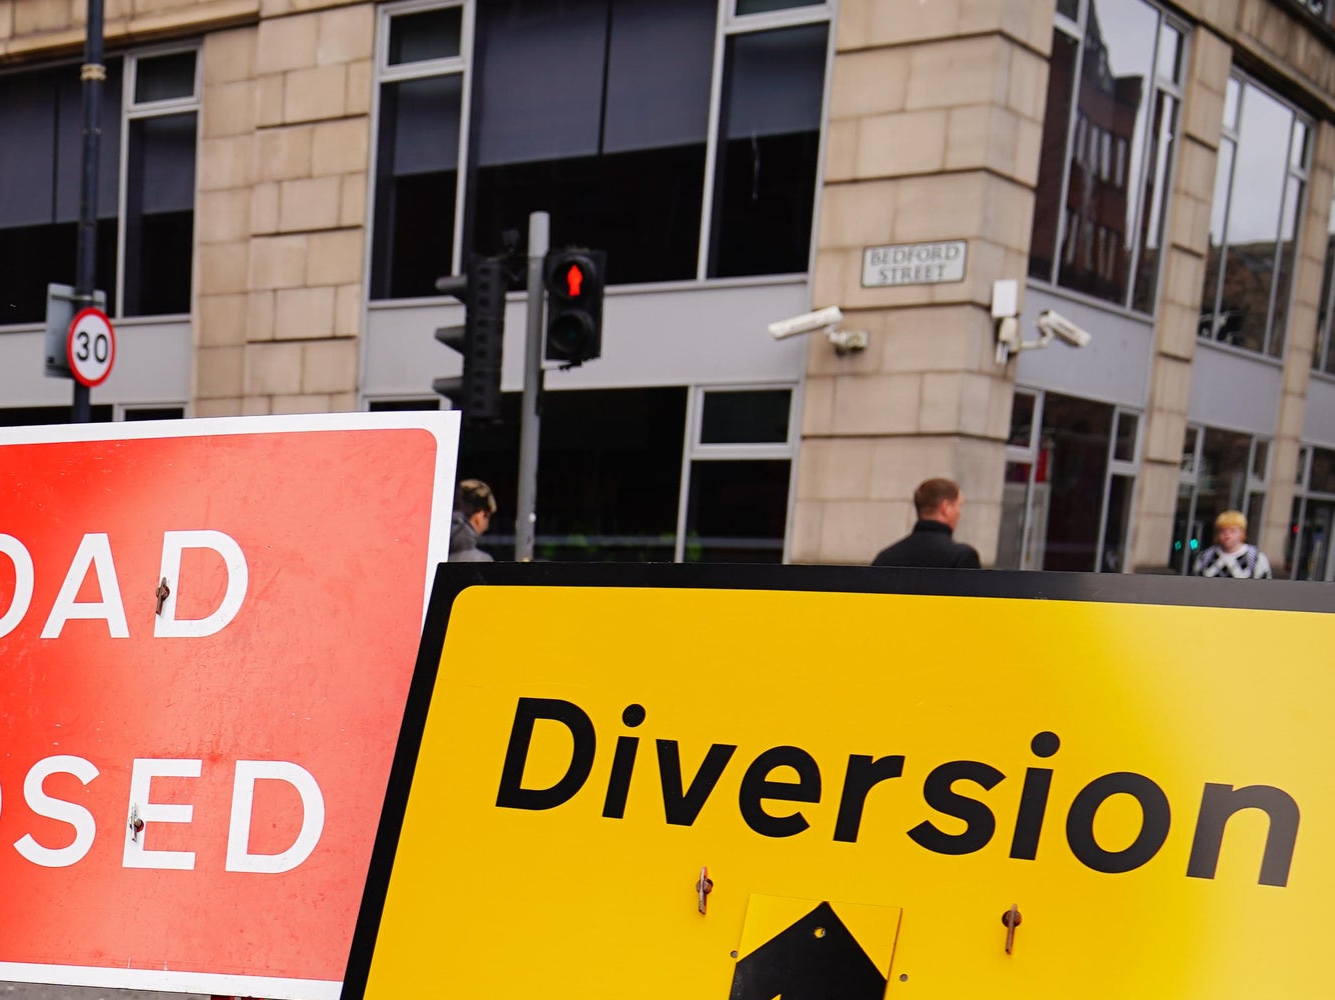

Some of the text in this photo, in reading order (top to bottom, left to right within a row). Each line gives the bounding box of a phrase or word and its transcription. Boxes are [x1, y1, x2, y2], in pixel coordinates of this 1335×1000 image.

[870, 245, 959, 266] BEDFORD
[879, 264, 946, 281] STREET
[77, 331, 109, 363] 30
[495, 696, 1302, 888] Diversion
